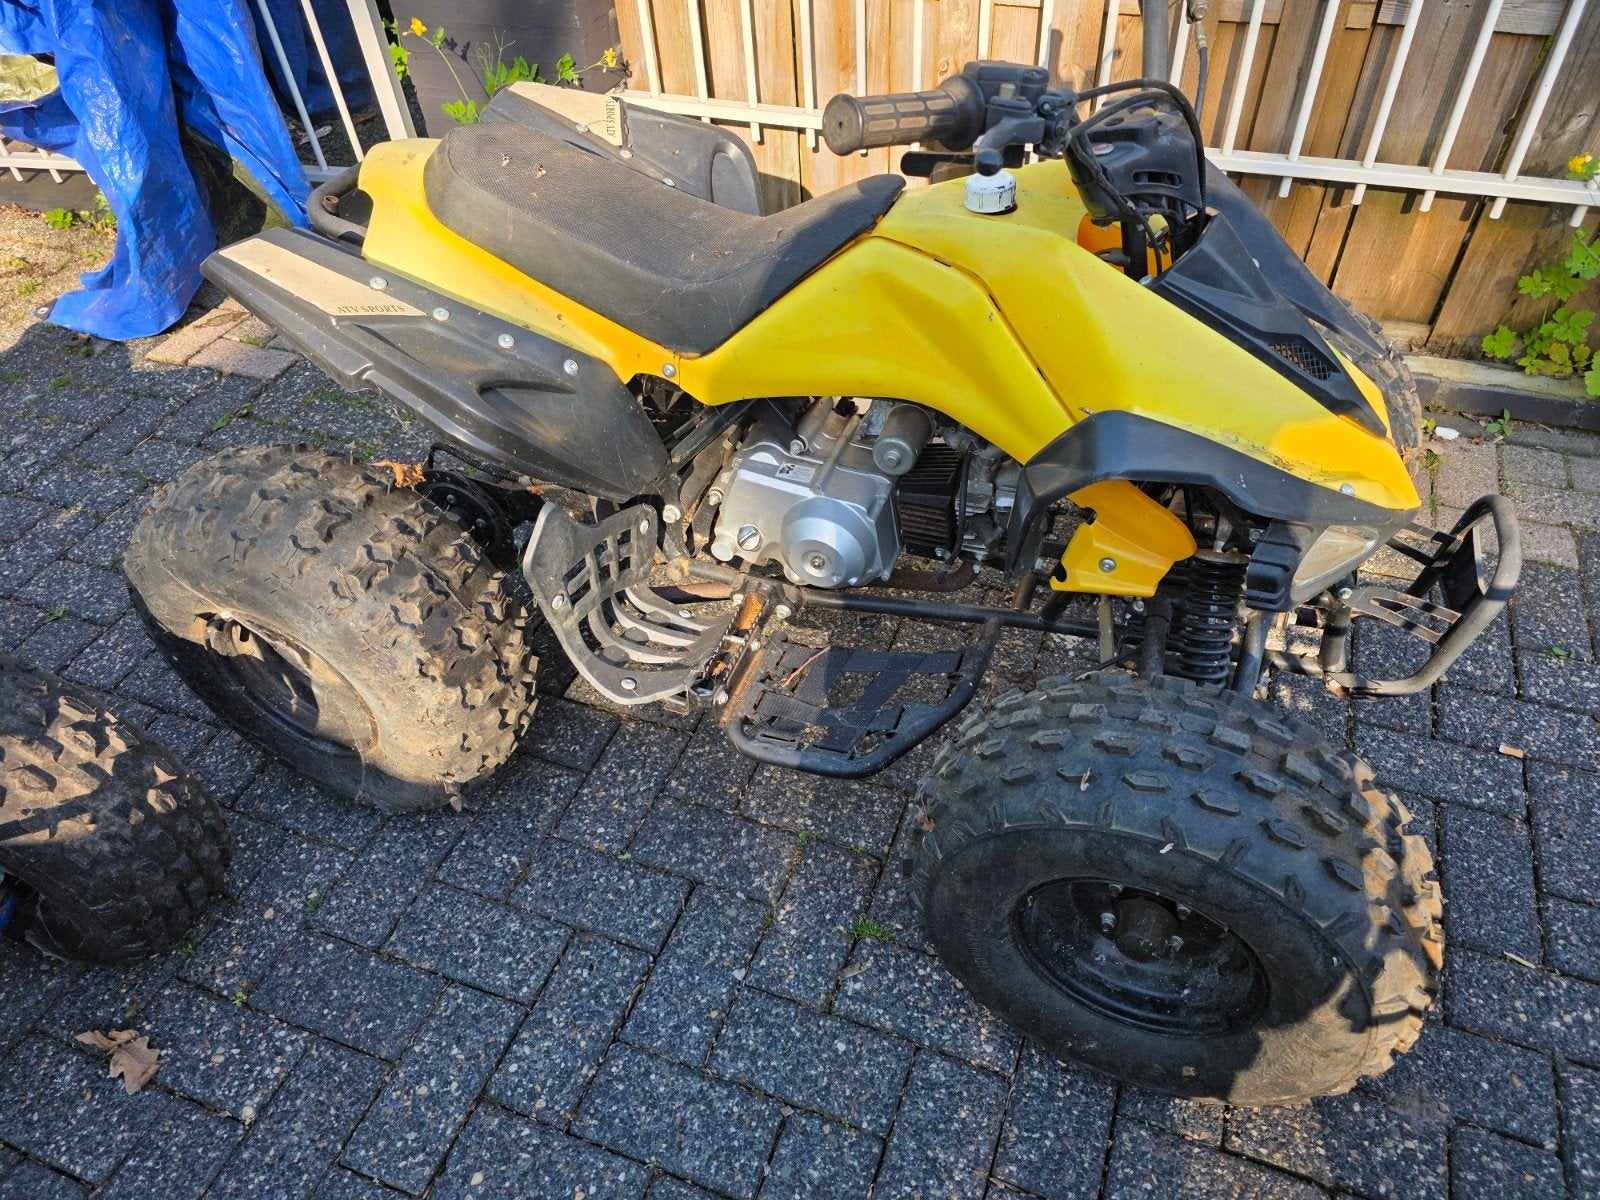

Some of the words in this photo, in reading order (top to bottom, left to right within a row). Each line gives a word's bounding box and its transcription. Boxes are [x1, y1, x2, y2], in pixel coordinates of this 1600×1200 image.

[606, 100, 616, 123] SPORTS
[606, 124, 616, 137] ATV
[337, 305, 359, 314] ATV
[360, 304, 406, 313] SPORTS
